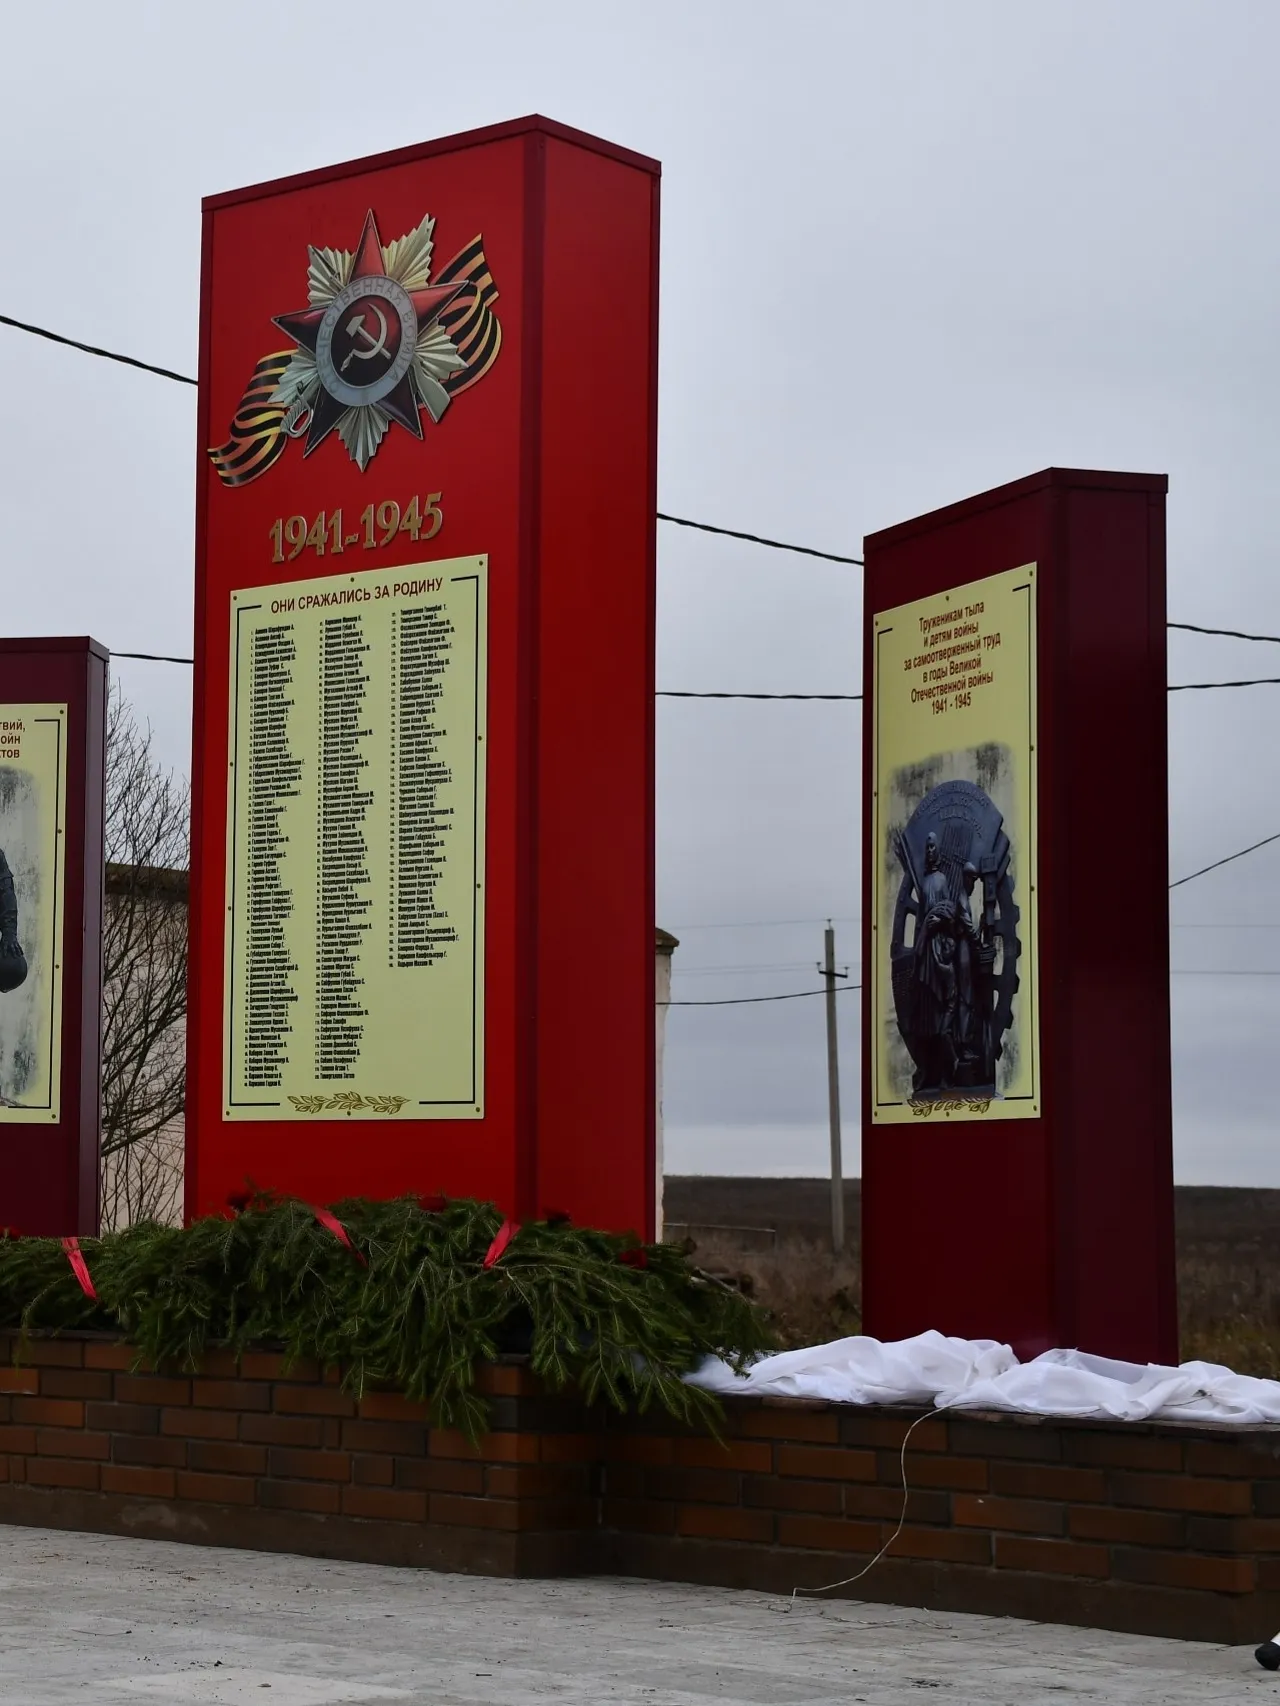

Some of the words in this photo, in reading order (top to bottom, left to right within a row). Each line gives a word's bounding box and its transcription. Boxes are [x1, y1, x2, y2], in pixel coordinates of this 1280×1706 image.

[269, 492, 443, 563] 1941-1945
[271, 598, 295, 614] ОНИ
[298, 588, 371, 610] СРАЖАЛИСЬ
[374, 586, 390, 600] ЗА
[393, 578, 443, 598] РОДИНУ
[919, 609, 963, 634] Труженикам
[965, 602, 985, 618] тыла
[924, 636, 928, 647] и
[930, 630, 952, 647] детям
[954, 621, 979, 638] войны
[904, 659, 912, 671] за
[913, 635, 981, 668] самоотверженный
[983, 632, 1001, 650] труд
[923, 672, 928, 683] в
[929, 665, 948, 682] годы
[950, 653, 981, 675] Великой
[911, 675, 966, 703] Отечественной
[968, 671, 993, 688] войны
[932, 699, 947, 715] 1941
[955, 692, 971, 708] 1945
